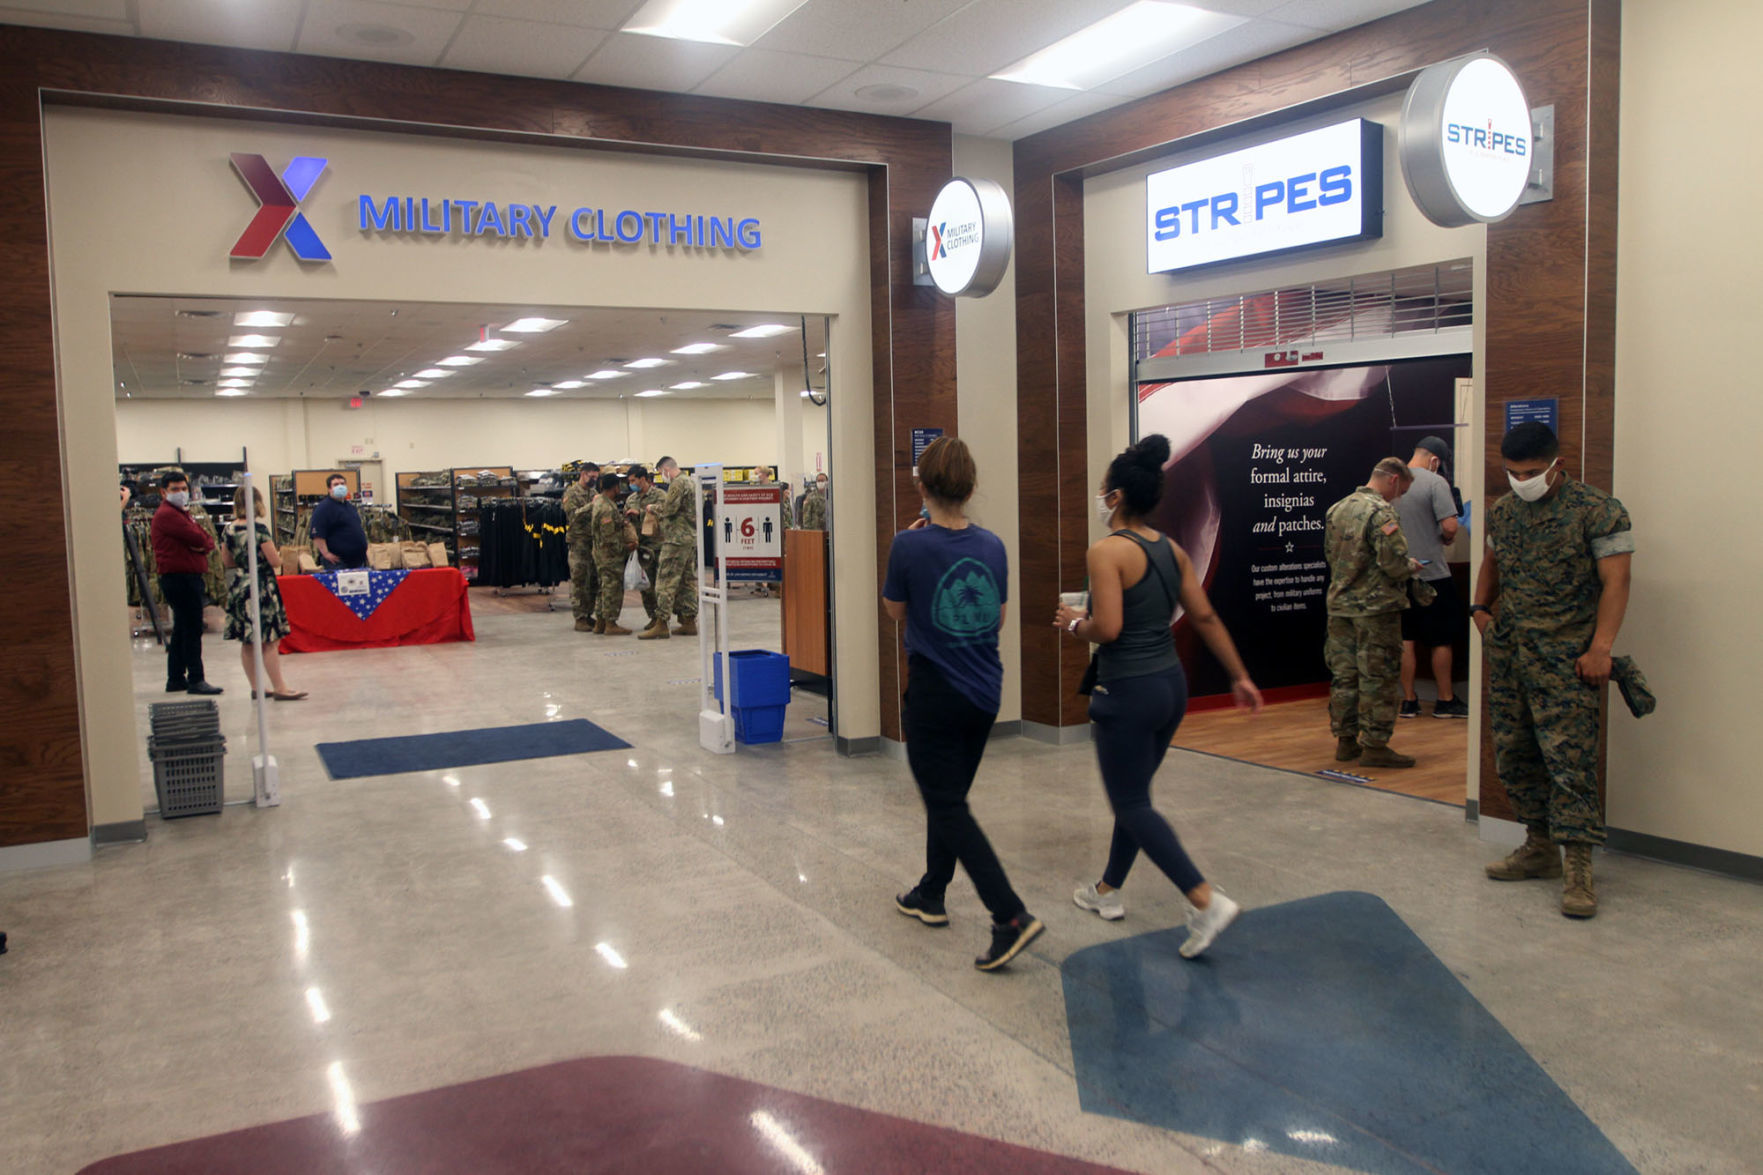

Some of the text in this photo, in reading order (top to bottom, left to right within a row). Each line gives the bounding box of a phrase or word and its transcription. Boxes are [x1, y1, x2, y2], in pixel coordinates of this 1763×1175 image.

[358, 194, 762, 249] MILITARY CLOTHING
[947, 222, 976, 239] MILITARY
[946, 233, 979, 251] CLOTHING
[1251, 443, 1327, 464] Bring us your
[1250, 467, 1327, 485] formal attire,
[1264, 493, 1315, 512] insignias
[741, 516, 755, 537] 6
[1252, 515, 1325, 537] and patches.
[1295, 576, 1300, 584] to
